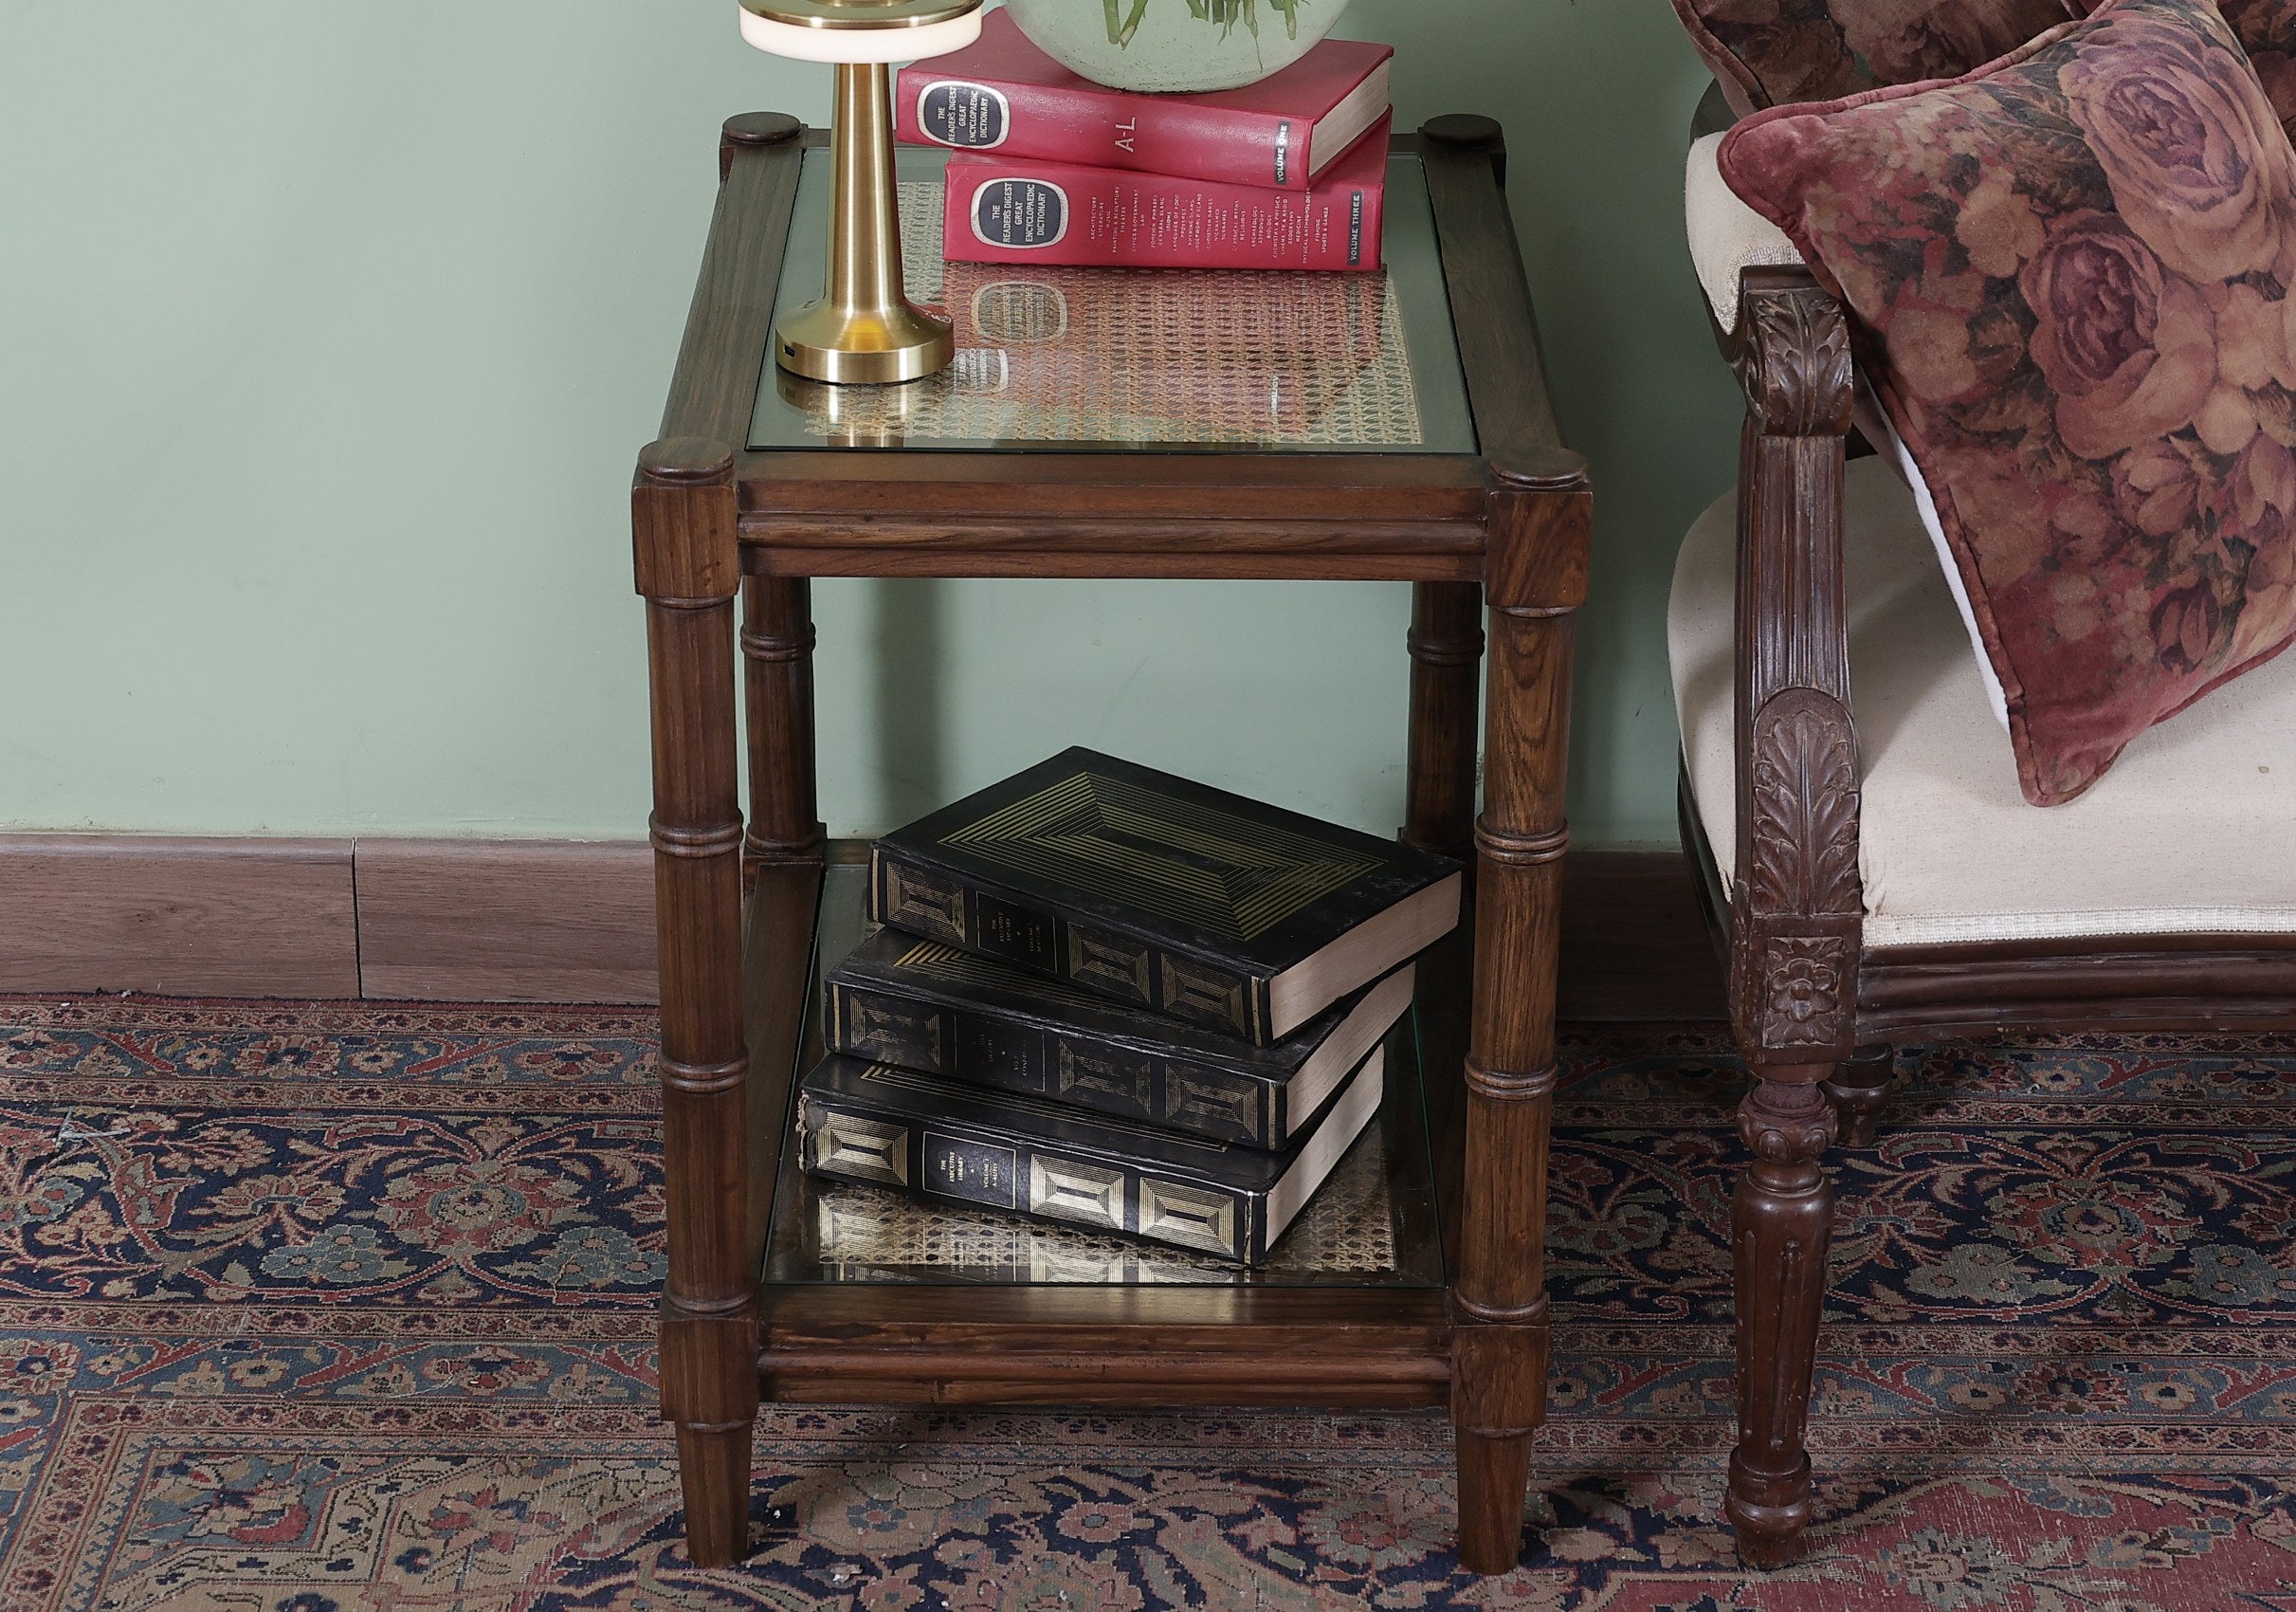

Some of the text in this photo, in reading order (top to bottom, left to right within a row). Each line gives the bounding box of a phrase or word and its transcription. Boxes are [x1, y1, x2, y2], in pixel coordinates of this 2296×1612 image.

[948, 86, 957, 111] DIGEST
[958, 104, 967, 127] GREAT
[969, 90, 978, 143] ENCYCLOPAEDIC
[980, 97, 989, 138] DICTIONARY
[1115, 117, 1136, 153] A-L
[1004, 182, 1012, 209] DIGEST
[992, 205, 1001, 220] THE
[1014, 201, 1023, 226] GREAT
[1026, 184, 1035, 243] ENCYCLOPAEDIC
[1037, 192, 1047, 236] DICTIONARY
